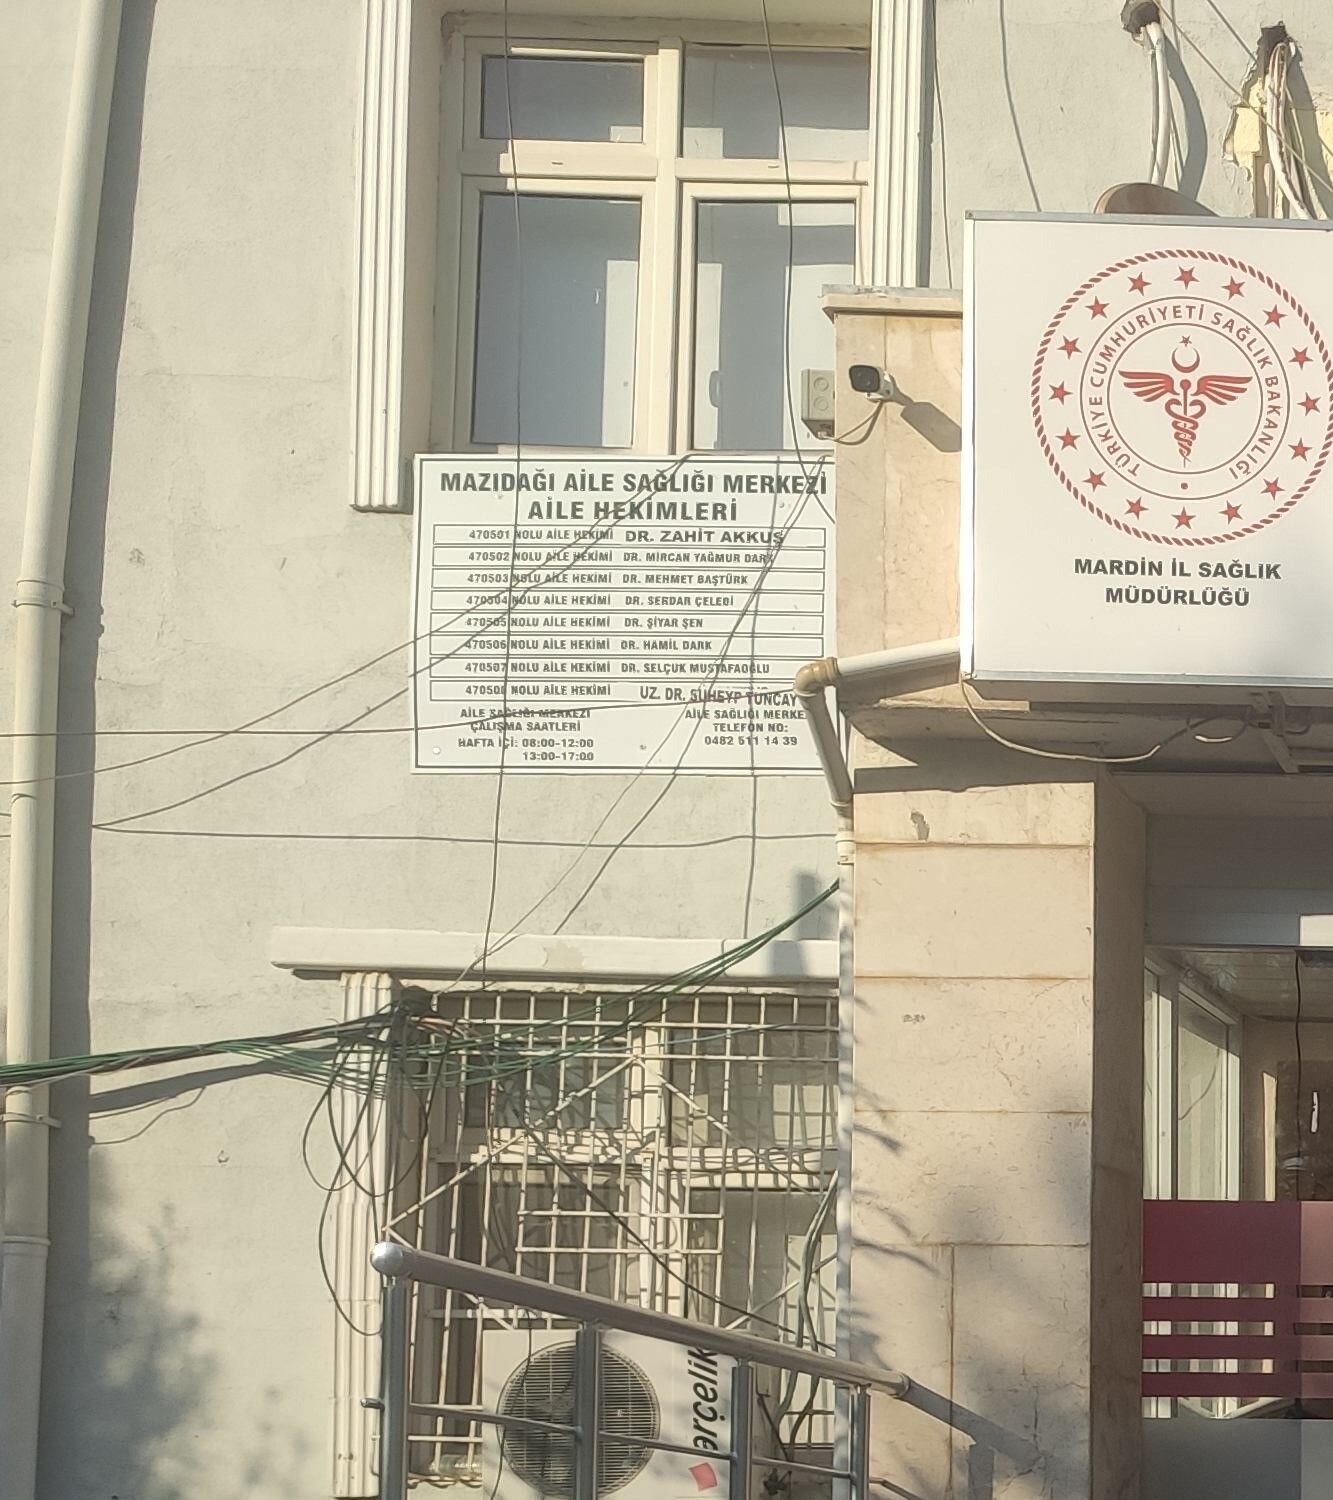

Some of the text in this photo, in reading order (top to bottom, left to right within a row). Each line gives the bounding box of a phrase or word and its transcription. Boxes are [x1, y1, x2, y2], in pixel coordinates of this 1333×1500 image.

[1088, 303, 1281, 481] TÜRKİYE CUMHURİYETİ SAĞLIK BAKANLIĞI
[440, 468, 827, 495] MAZIDAĞI AİLE SAĞLIĞI MERKEZİ
[527, 496, 738, 521] AİLE HEKİMLERİ
[468, 530, 510, 540] 470501
[514, 530, 543, 540] NOLU
[546, 528, 570, 540] AİLE
[574, 528, 614, 540] HEKİMİ
[625, 530, 655, 543] DR.
[659, 527, 715, 543] ZAHİT
[468, 552, 510, 561] 470502
[513, 552, 542, 561] NOLU
[546, 550, 569, 561] AİLE
[573, 550, 613, 561] HEKİMİ
[623, 552, 642, 562] DR.
[1073, 557, 1282, 580] MARDİN İL SAĞLIK
[467, 572, 748, 586] 470503 NOLU AİLE HEKİMİ DR. MEHMET BAŞTÜRK
[511, 596, 540, 605] NOLU
[543, 594, 567, 605] AİLE
[571, 594, 611, 605] HEKİMİ
[625, 595, 644, 606] DR.
[647, 595, 691, 606] SERDAR
[1105, 584, 1252, 608] MÜDÜRLÜĞÜ
[510, 617, 539, 627] NOLU
[543, 615, 567, 627] AİLE
[570, 615, 610, 627] HEKİMİ
[624, 618, 643, 628] DR.
[647, 616, 678, 630] ŞİYAR
[682, 618, 703, 630] ŞEN
[510, 640, 539, 649] NOLU
[542, 638, 567, 649] AİLE
[570, 638, 610, 649] HEKİMİ
[621, 640, 639, 650] DR.
[643, 638, 678, 650] HAMİL
[682, 640, 712, 650] DARK
[465, 663, 506, 672] 470507
[510, 663, 539, 672] NOLU
[542, 661, 567, 672] AİLE
[570, 661, 610, 672] HEKİMİ
[621, 663, 640, 673] DR.
[643, 663, 686, 676] SELÇUK
[511, 686, 539, 695] NOLU
[543, 684, 568, 695] AİLE
[571, 684, 611, 695] HEKİMİ
[640, 686, 661, 700] UZ.
[665, 687, 686, 701] DR.
[460, 706, 486, 718] AİLE
[685, 708, 807, 720] AİLE SAĞLIĞI MERKE
[470, 719, 581, 733] ÇALIŞMA SAATLERİ
[713, 723, 788, 733] TELEFON NO:
[458, 738, 494, 747] HAFTA
[522, 738, 594, 748] 08:00-12:00
[704, 736, 734, 746] 0482
[764, 736, 779, 746] 14
[782, 736, 798, 746] 39
[522, 751, 594, 761] 13:00-17:00
